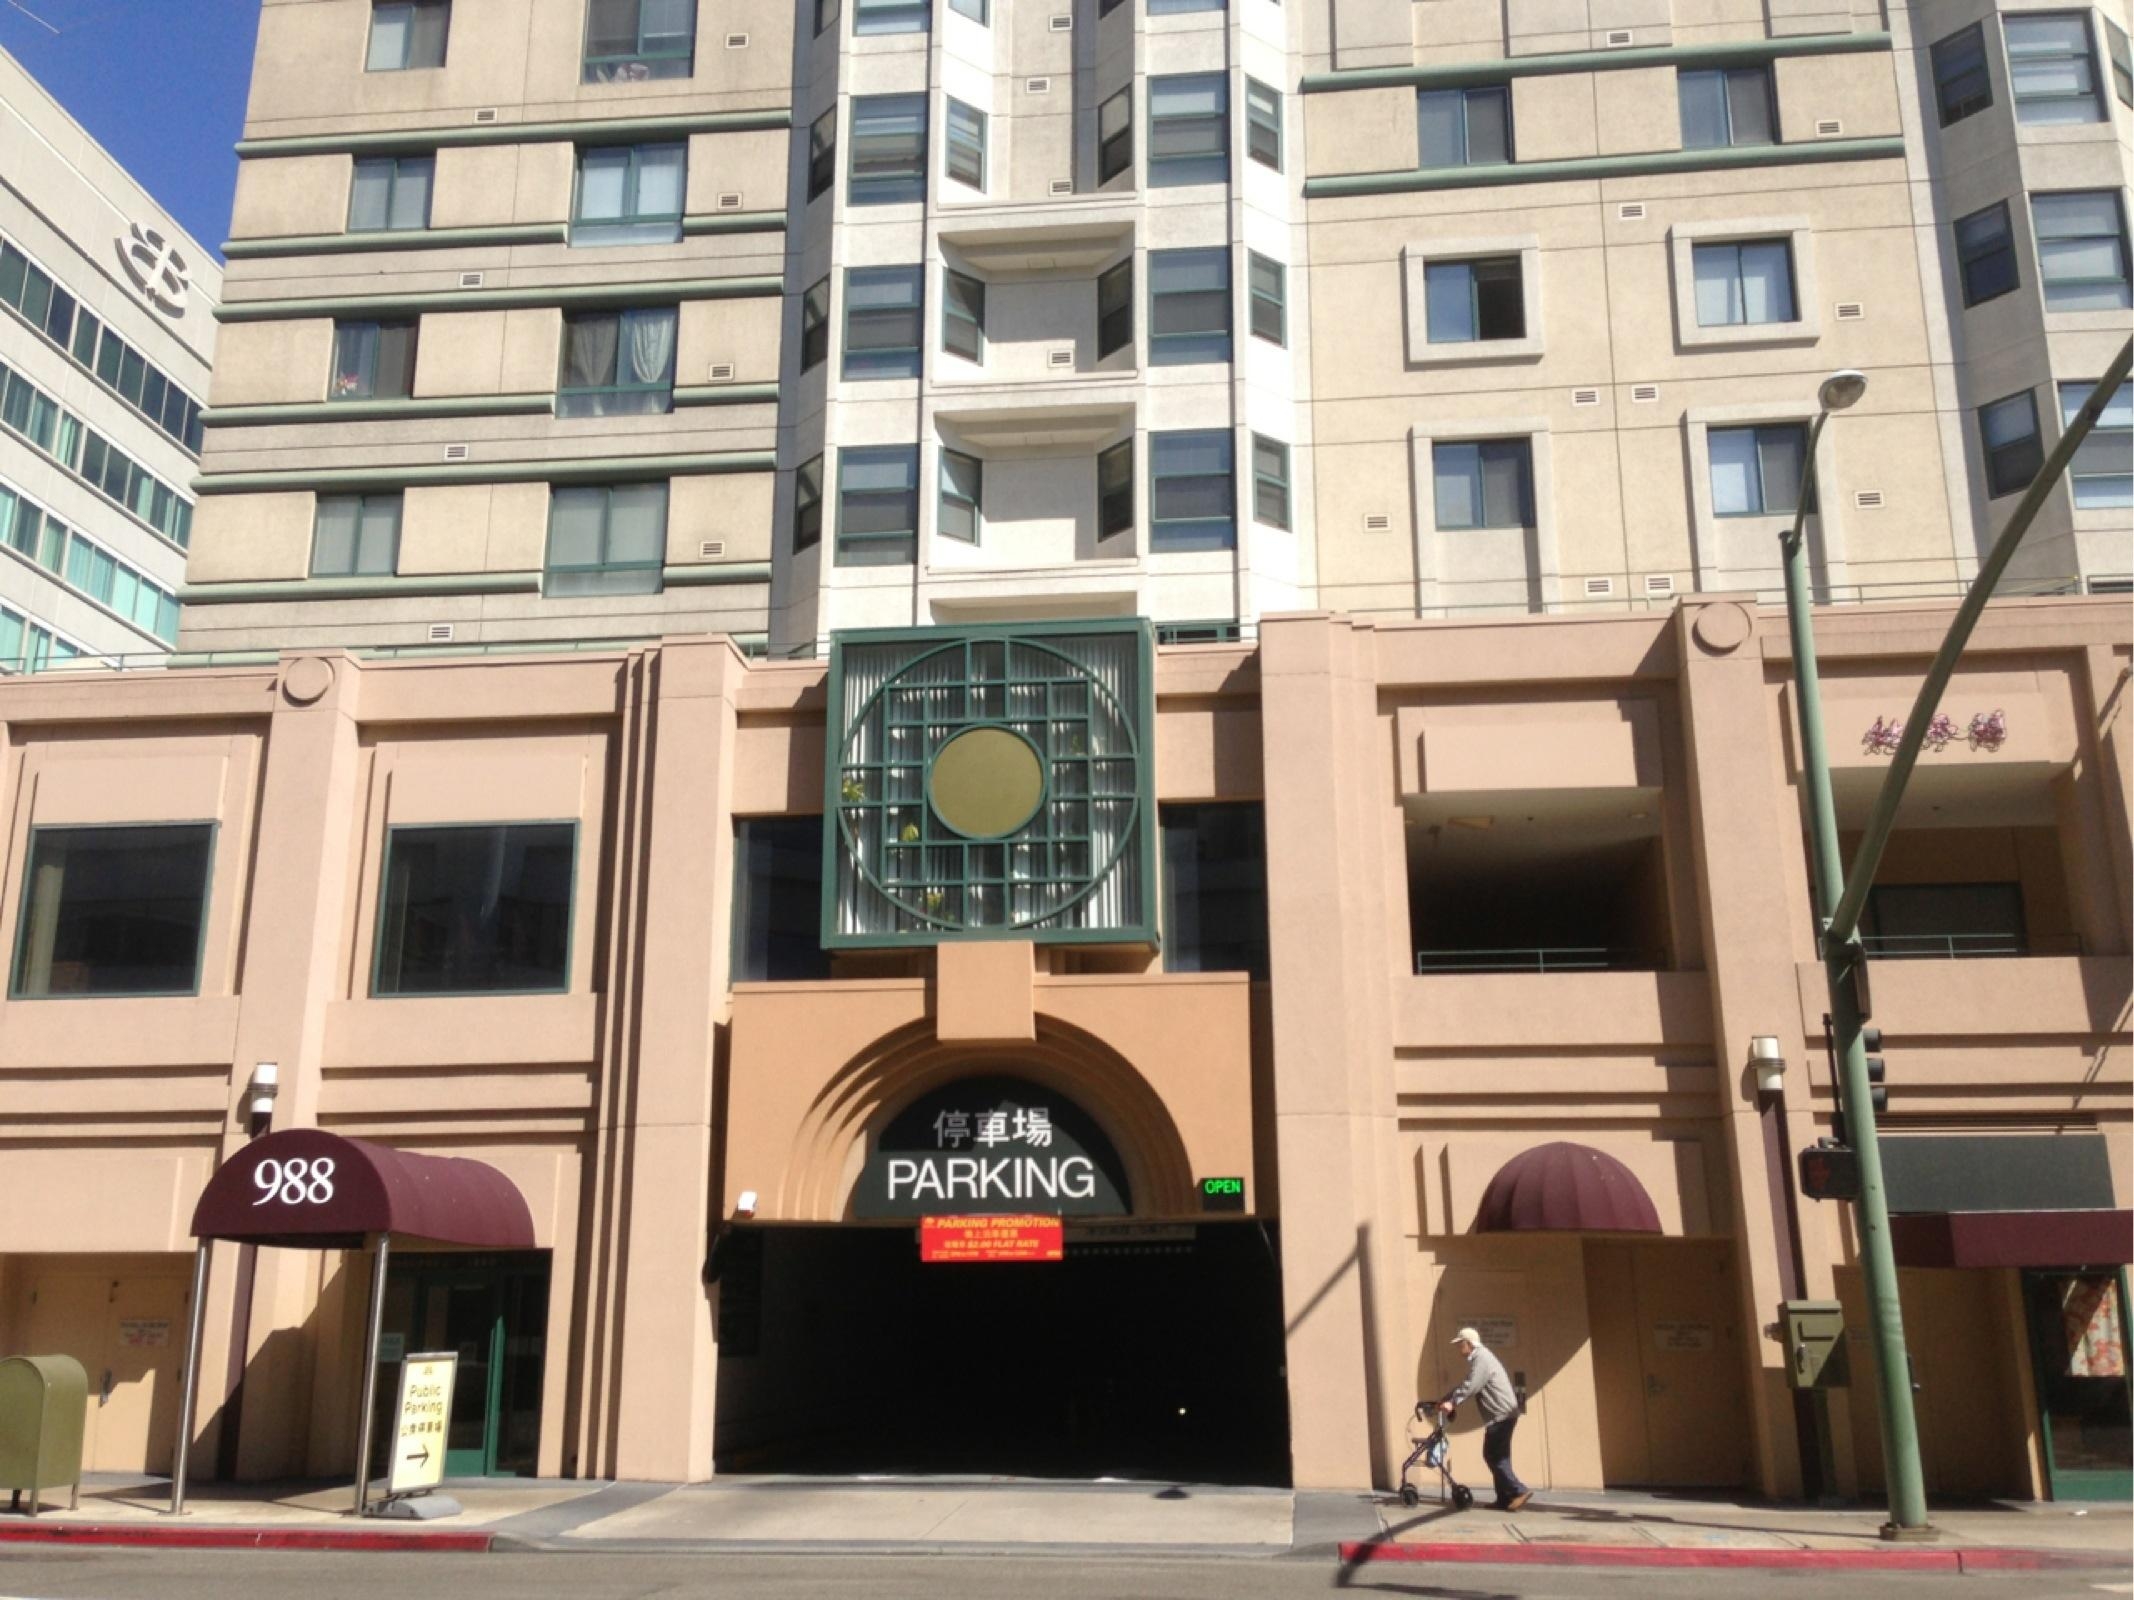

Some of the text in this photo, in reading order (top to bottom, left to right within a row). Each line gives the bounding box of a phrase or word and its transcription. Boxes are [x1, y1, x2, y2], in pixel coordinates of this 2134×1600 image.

[933, 1108, 1053, 1148] 停車場
[252, 1157, 336, 1206] 988
[888, 1156, 1095, 1200] PARKING
[1204, 1179, 1241, 1194] OPEN
[937, 1216, 1060, 1229] PARKING PROMOTION
[409, 1384, 442, 1398] Public
[404, 1400, 443, 1416] Parking
